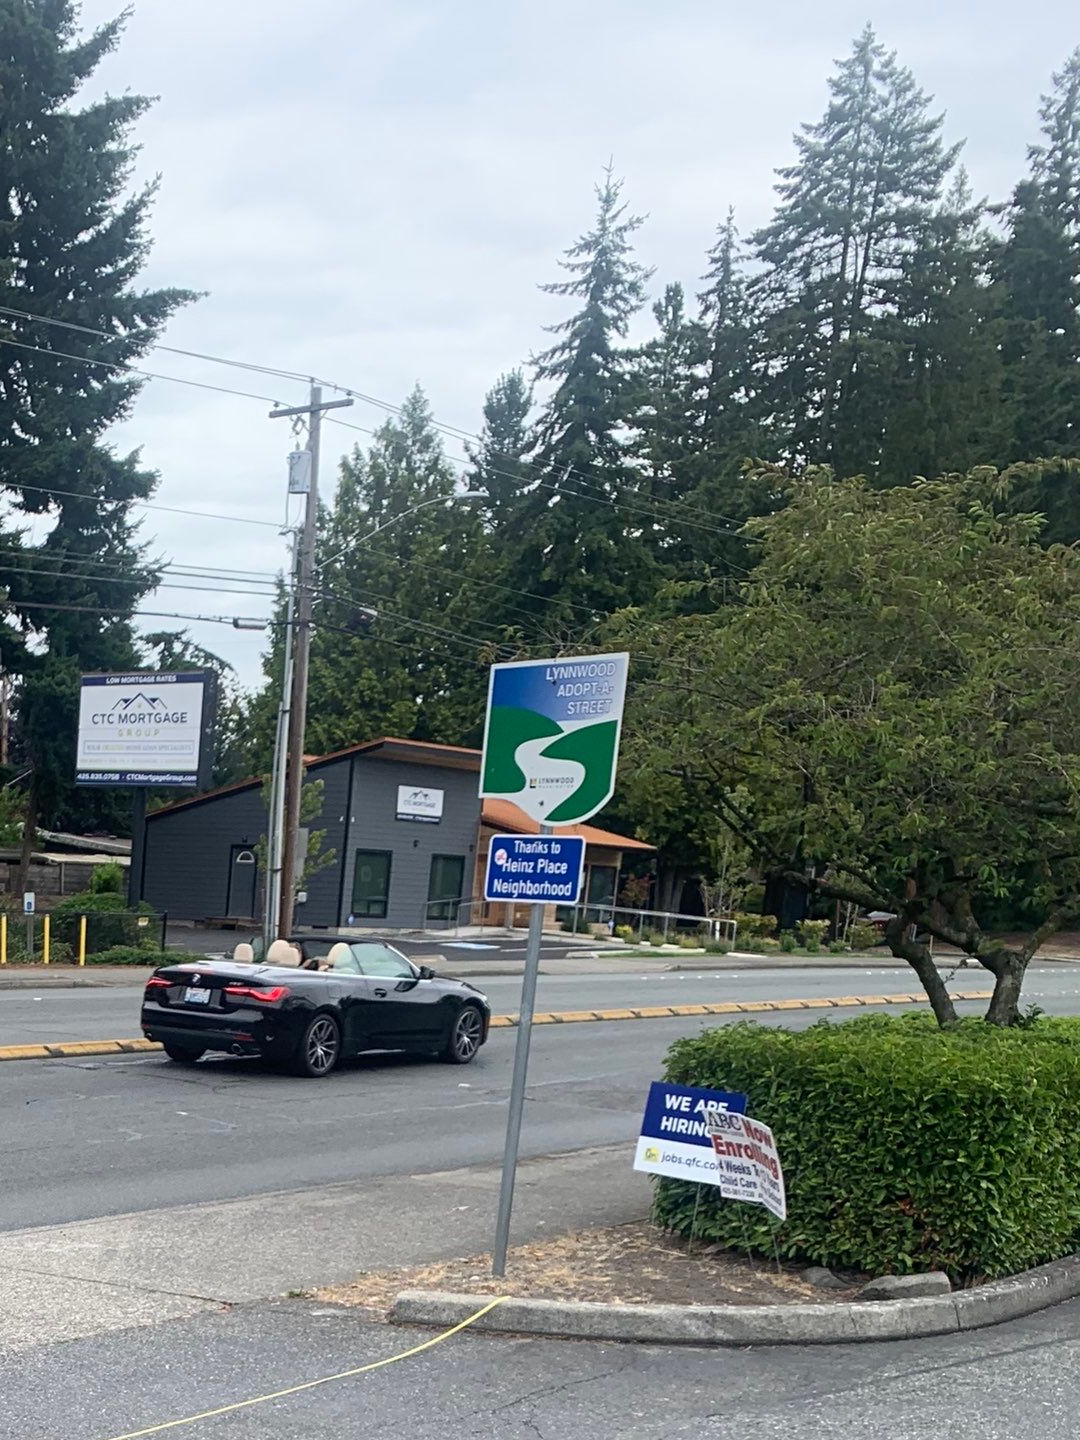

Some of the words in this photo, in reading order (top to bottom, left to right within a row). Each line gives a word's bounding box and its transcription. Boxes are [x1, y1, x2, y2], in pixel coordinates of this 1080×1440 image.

[545, 663, 616, 680] LYNNWOOD
[556, 682, 614, 697] ADOPT-A-
[567, 700, 613, 715] STREET
[91, 713, 115, 725] CTC
[118, 712, 188, 724] MORTGAGE
[117, 729, 160, 737] GROUP
[514, 840, 549, 854] Thanks
[550, 842, 562, 854] to
[502, 858, 535, 873] Heinz
[537, 859, 568, 874] Place
[493, 878, 573, 898] Neighborhood
[665, 1094, 692, 1112] WE
[694, 1099, 729, 1113] ARE
[741, 1117, 773, 1149] Now
[661, 1151, 718, 1170] jobs.qfc.co
[712, 1134, 779, 1180] Enrolling
